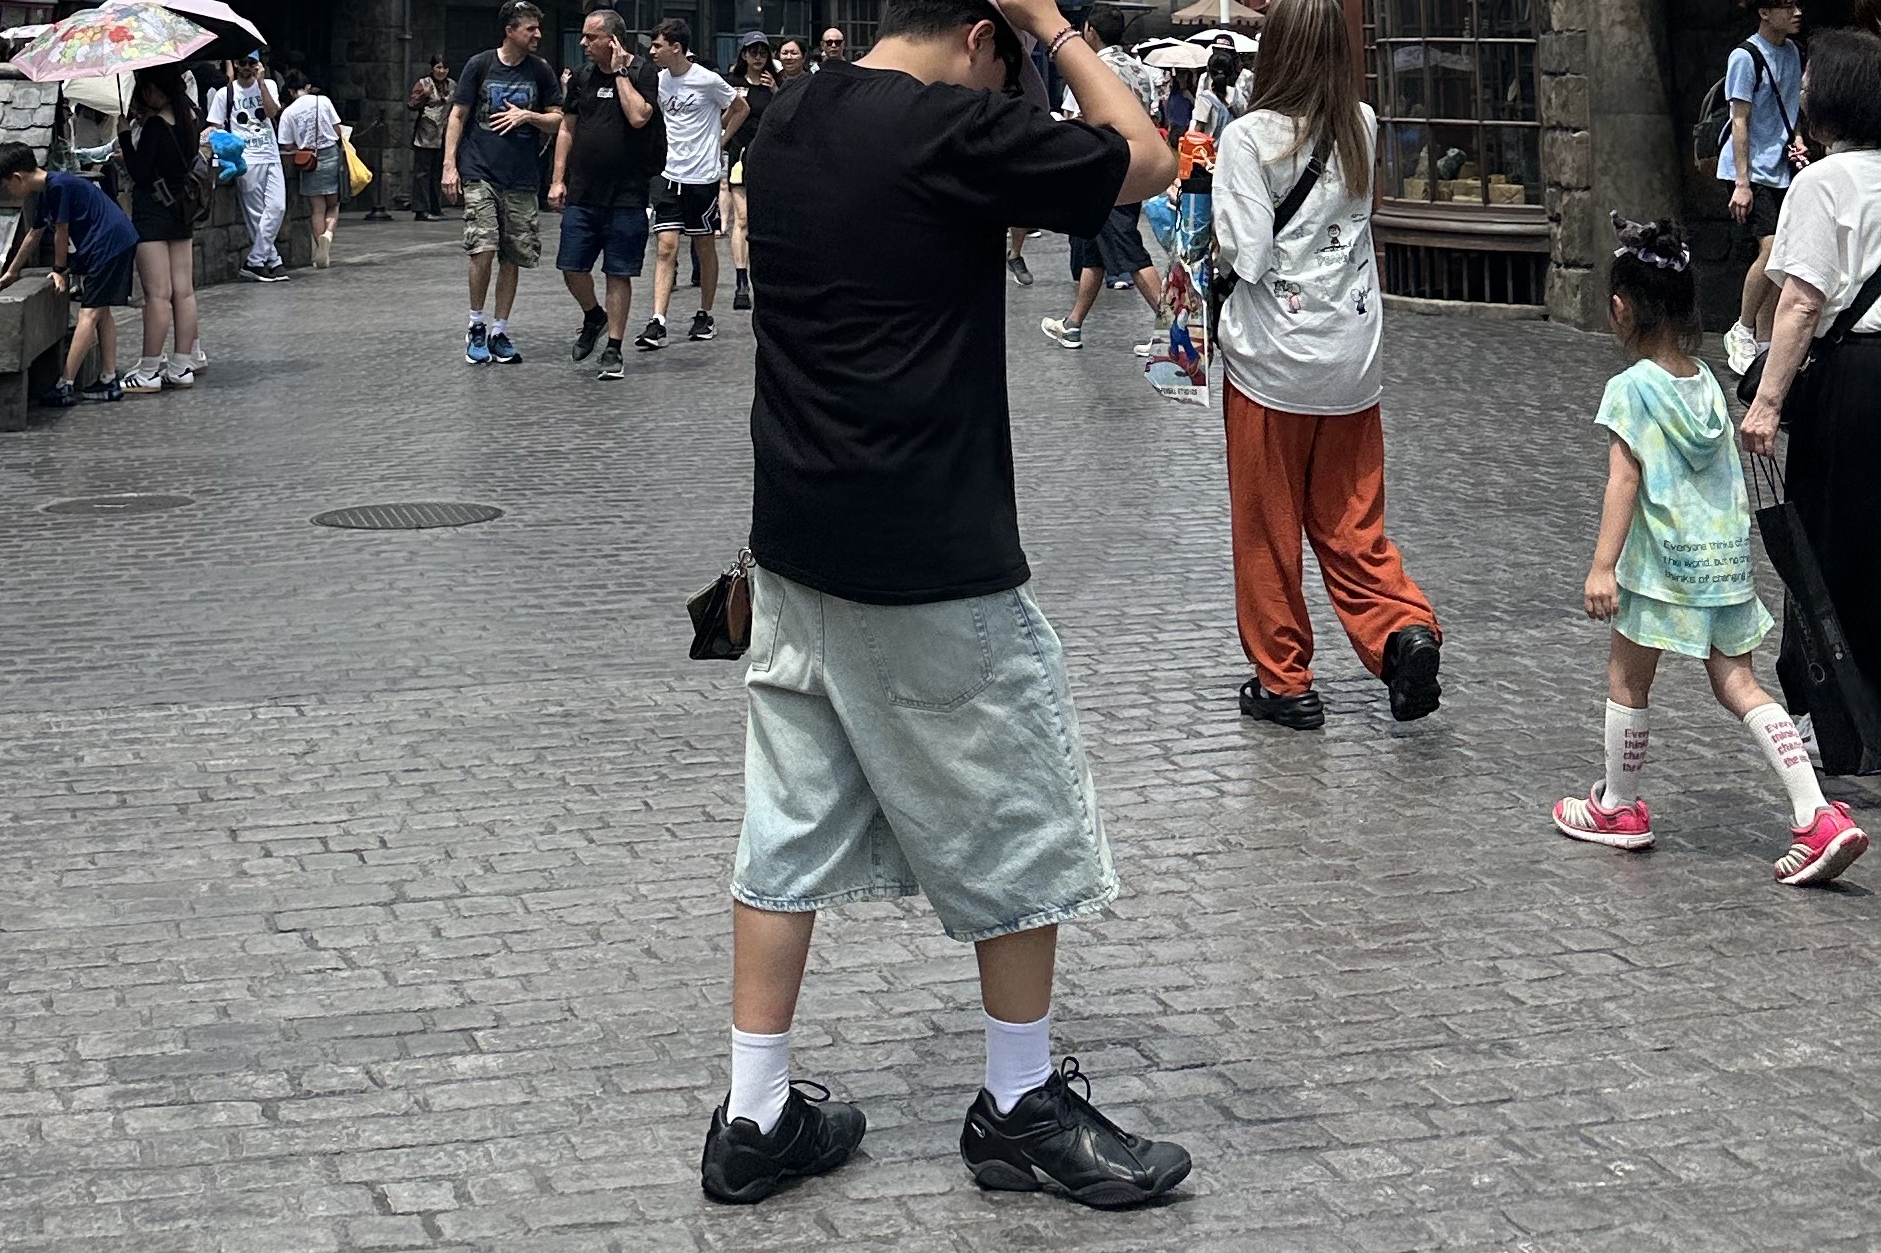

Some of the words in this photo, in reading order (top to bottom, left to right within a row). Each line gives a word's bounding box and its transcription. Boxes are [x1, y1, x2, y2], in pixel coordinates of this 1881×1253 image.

[1663, 539, 1707, 552] Everyone
[1709, 540, 1734, 549] thinks
[1663, 556, 1682, 566] the
[1664, 569, 1697, 584] thinks
[1698, 574, 1710, 584] of
